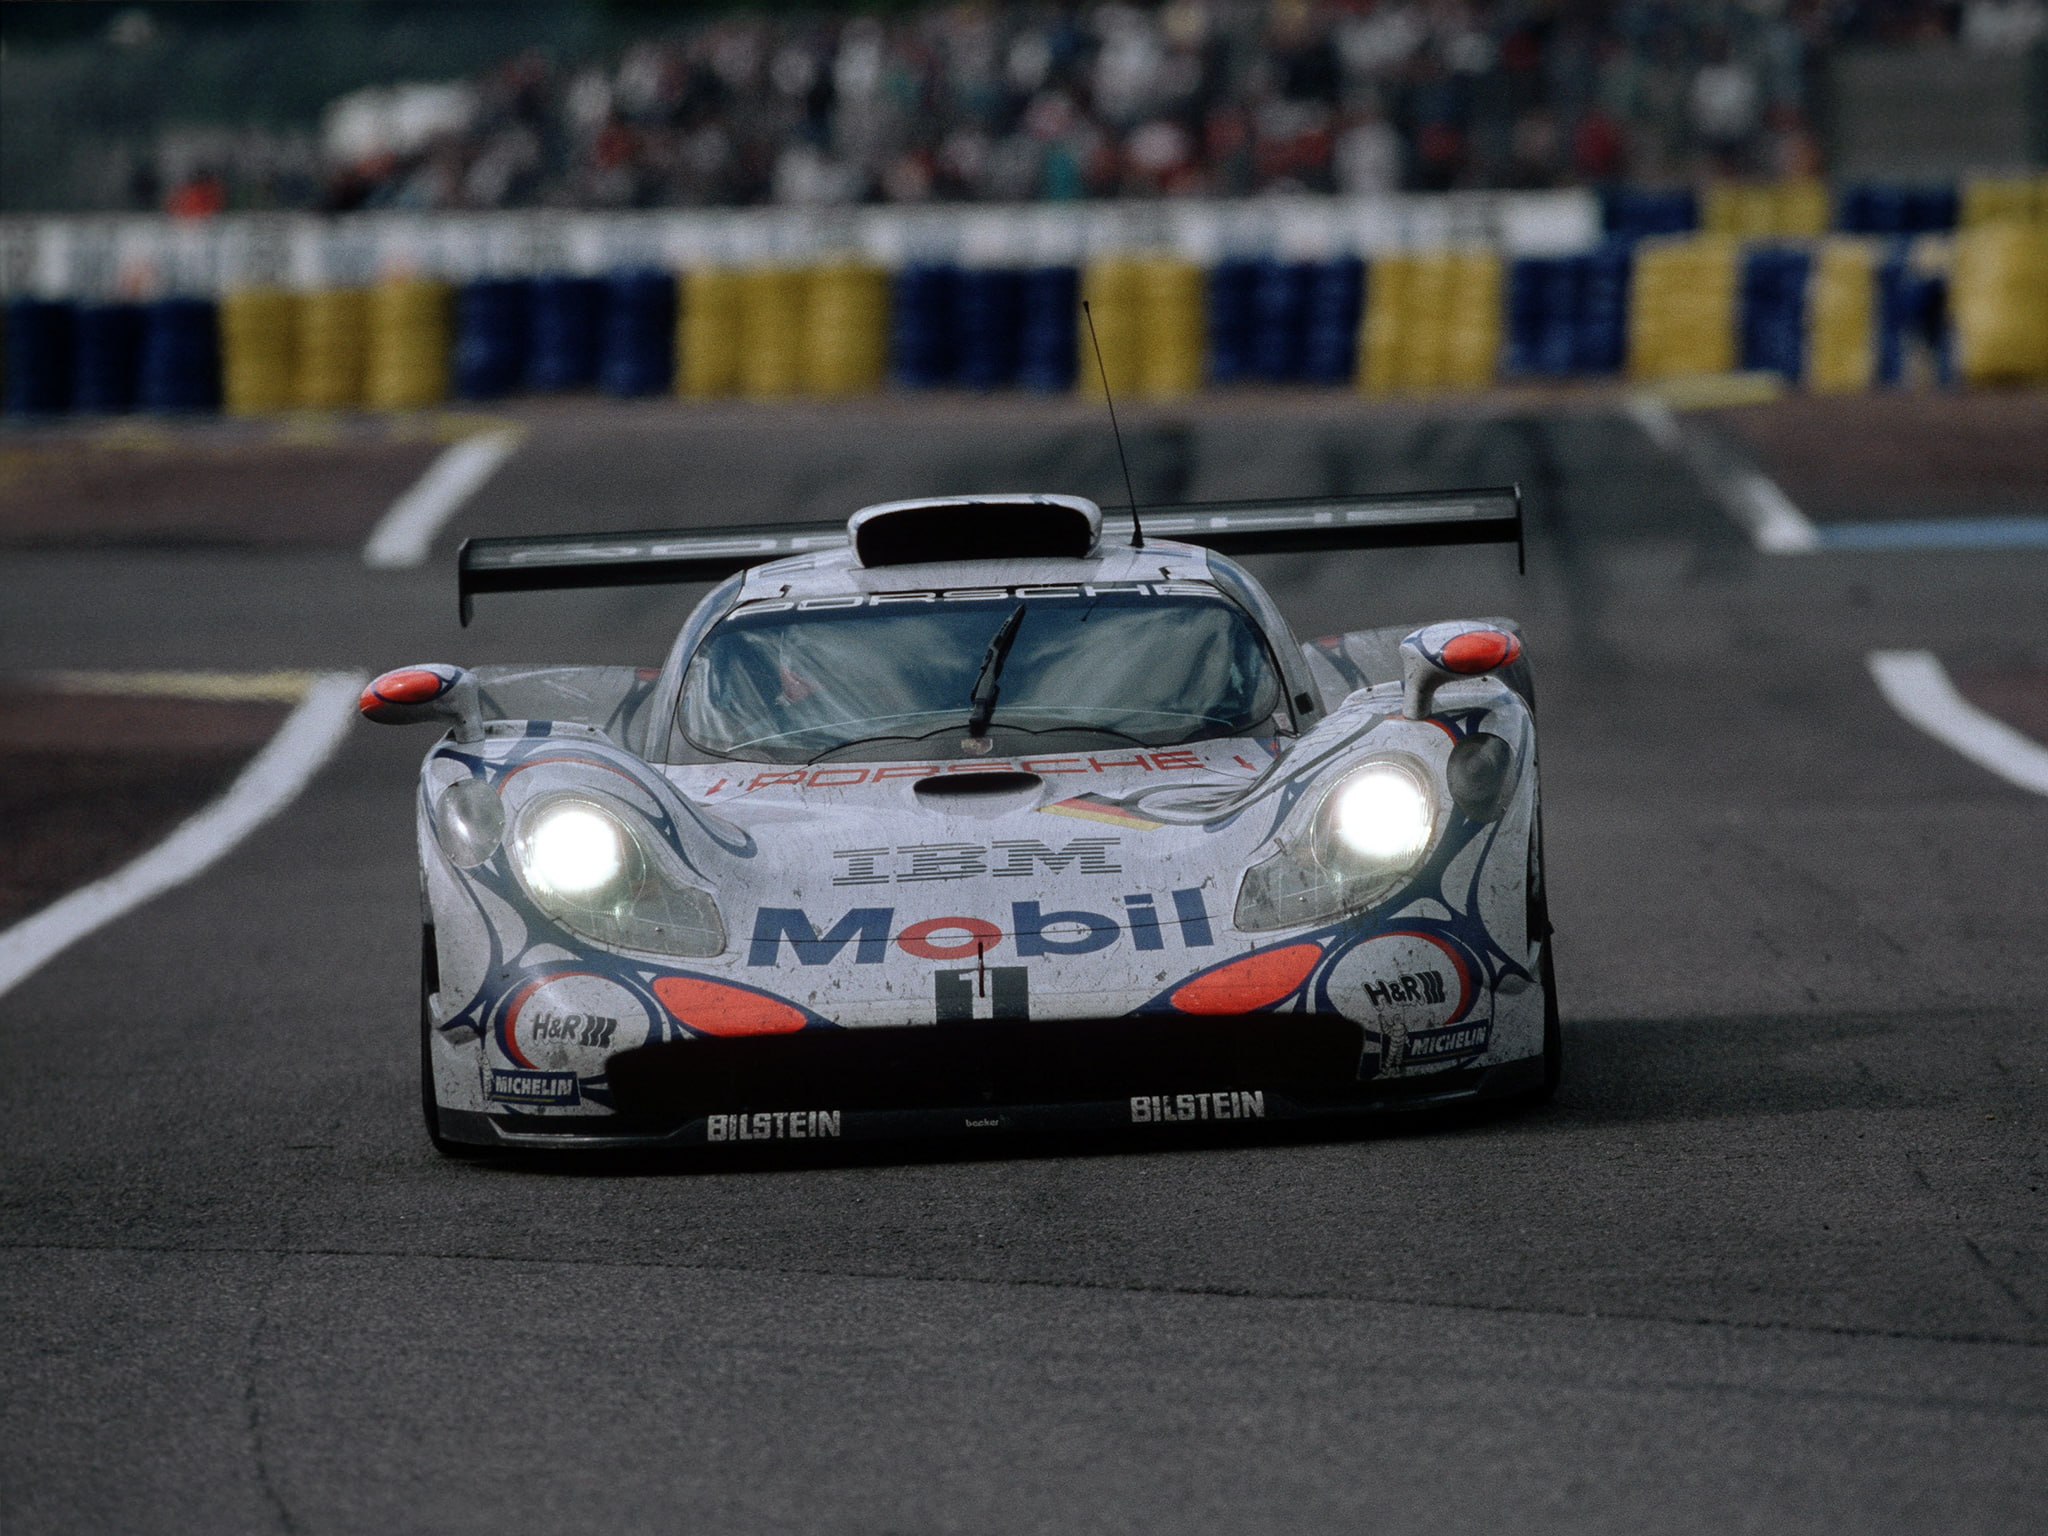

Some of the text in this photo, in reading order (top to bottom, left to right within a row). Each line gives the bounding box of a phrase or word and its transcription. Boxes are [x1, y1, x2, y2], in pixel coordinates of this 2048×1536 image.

[728, 584, 1222, 620] PORSCHE
[746, 751, 1204, 791] PORSCHE
[832, 837, 1122, 887] IBM
[747, 886, 1214, 967] Mobil
[1363, 976, 1419, 1006] H&R
[533, 1013, 579, 1043] H&R
[1411, 1026, 1487, 1056] MICHELIN
[496, 1075, 573, 1097] MICHELIN
[1130, 1091, 1266, 1123] BILSTEIN
[707, 1110, 841, 1142] BILSTEIN
